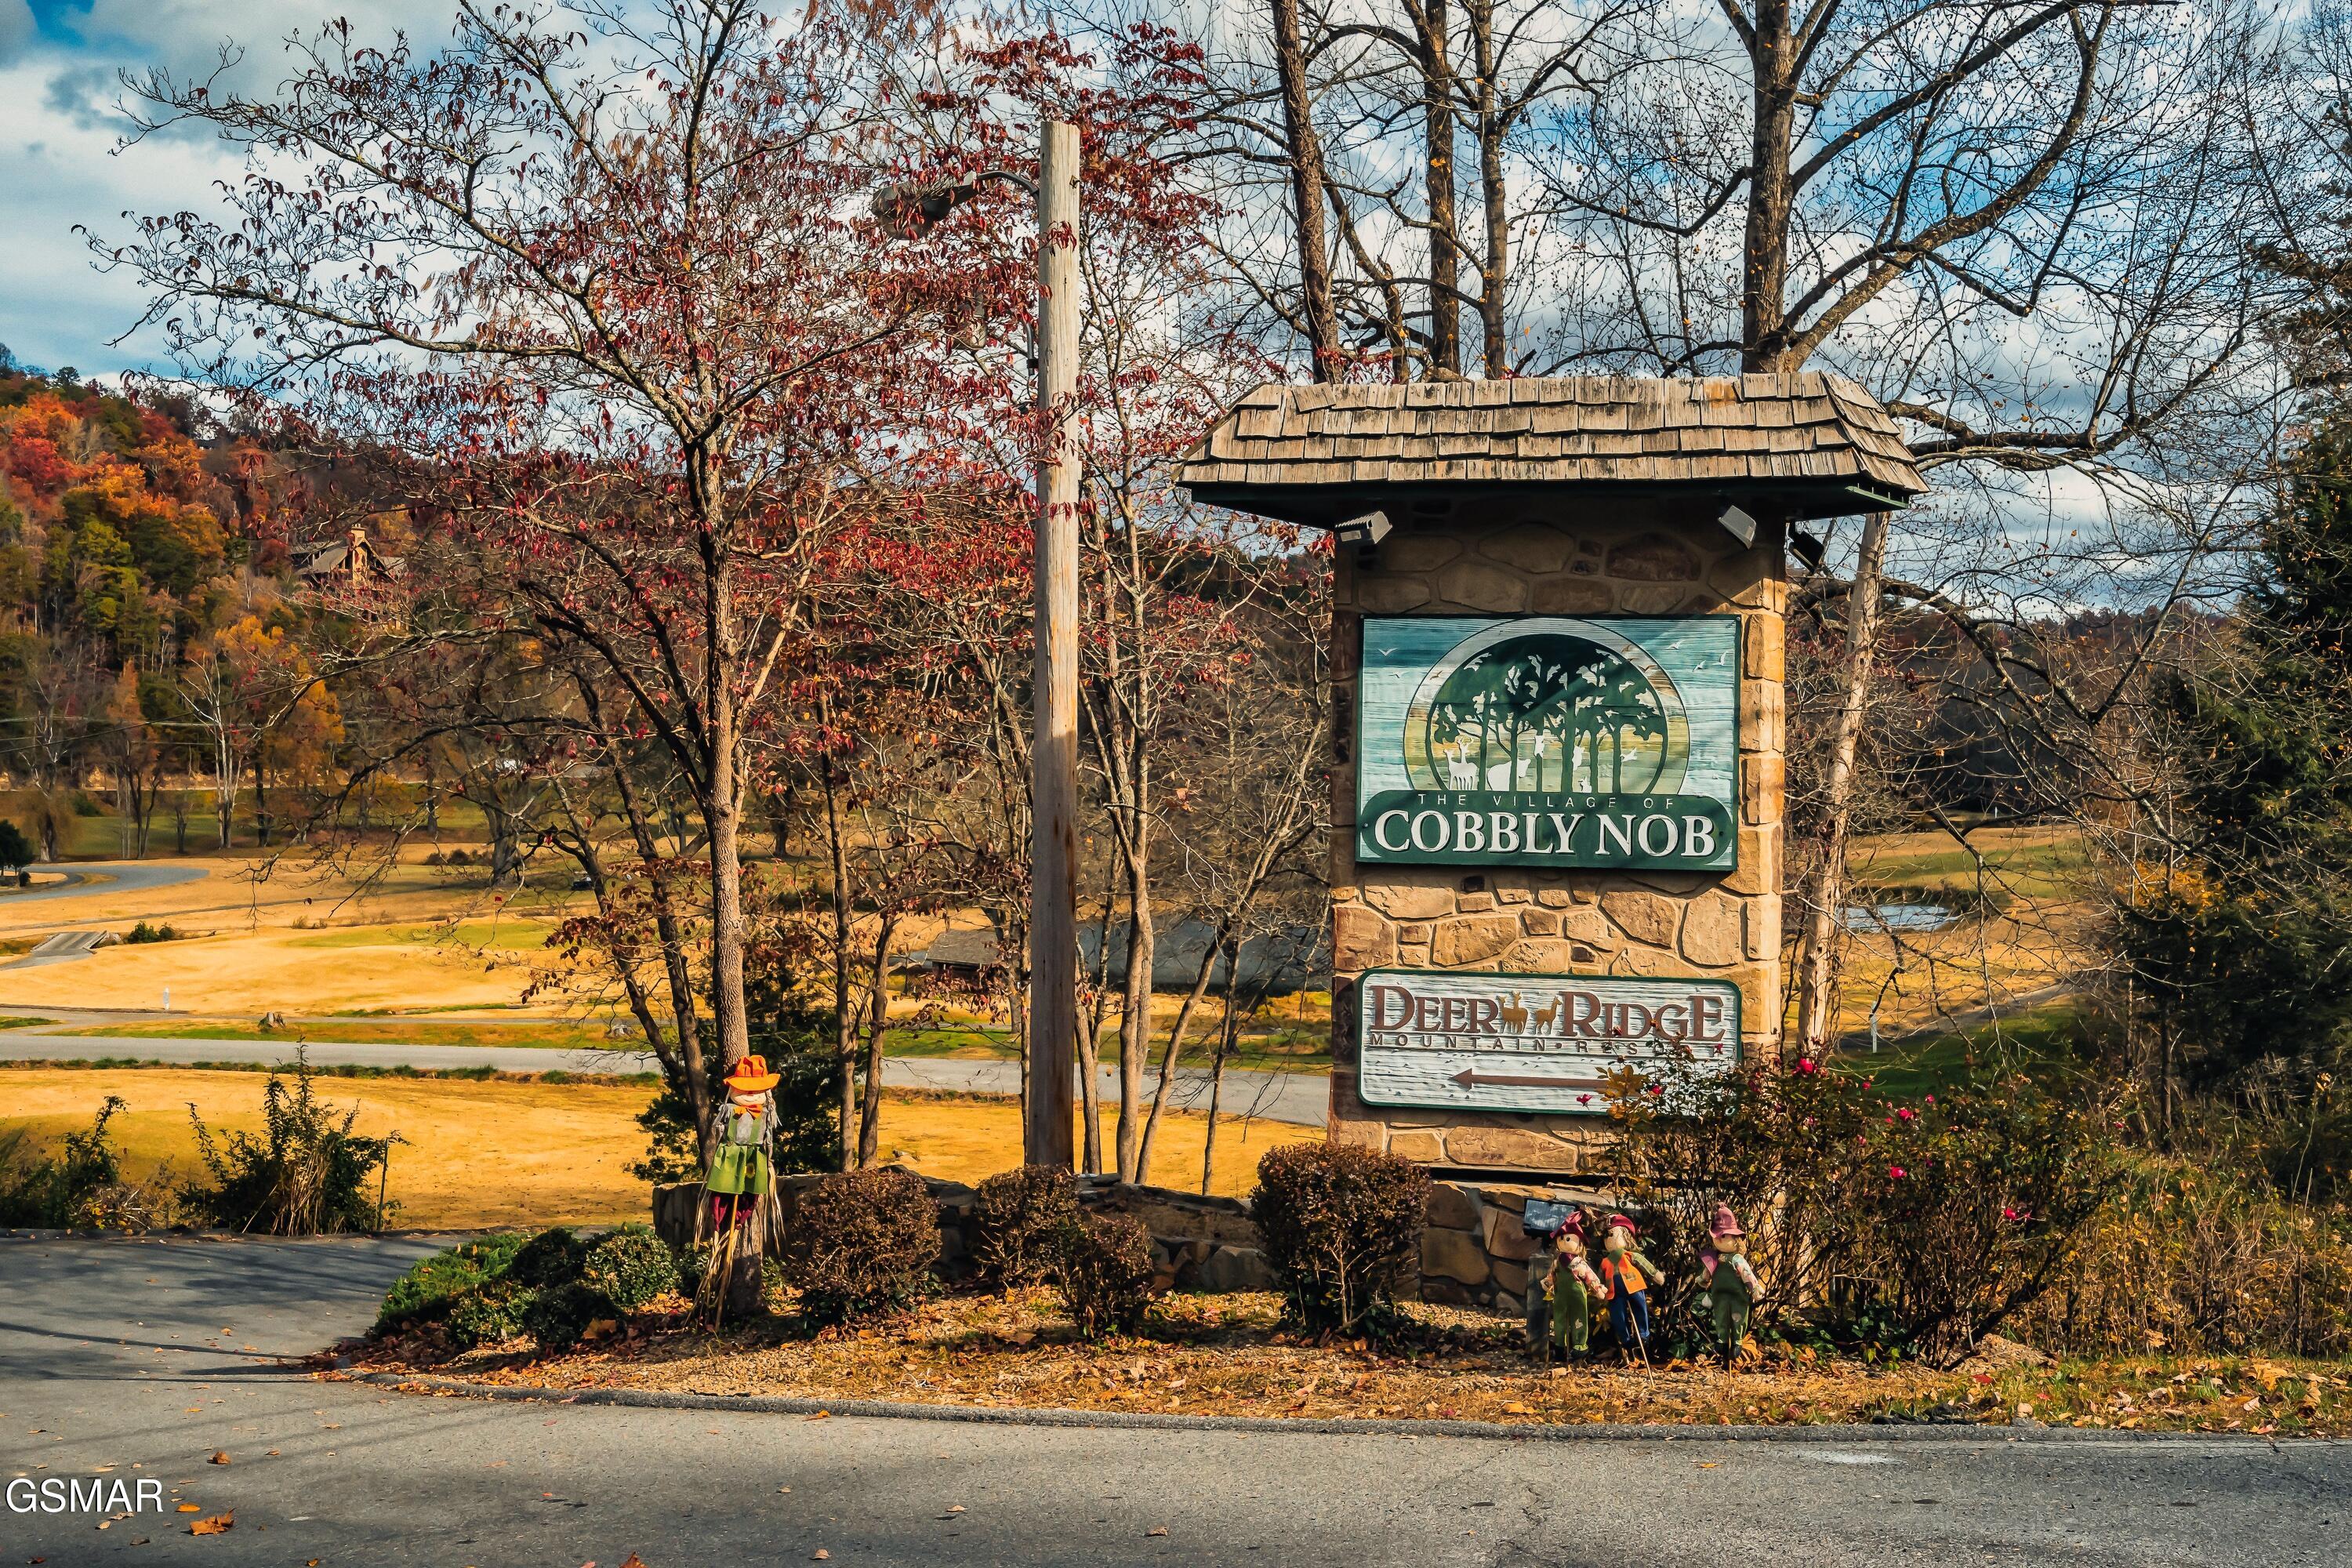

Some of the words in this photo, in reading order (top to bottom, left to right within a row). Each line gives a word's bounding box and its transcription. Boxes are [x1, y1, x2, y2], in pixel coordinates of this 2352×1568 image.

[1417, 793, 1467, 806] THE
[1493, 795, 1617, 808] VILLAGE
[1643, 797, 1674, 809] OF
[1374, 809, 1584, 854] COBBLY
[1595, 813, 1715, 858] NOB
[1371, 1033, 1546, 1052] MOUNTAIN
